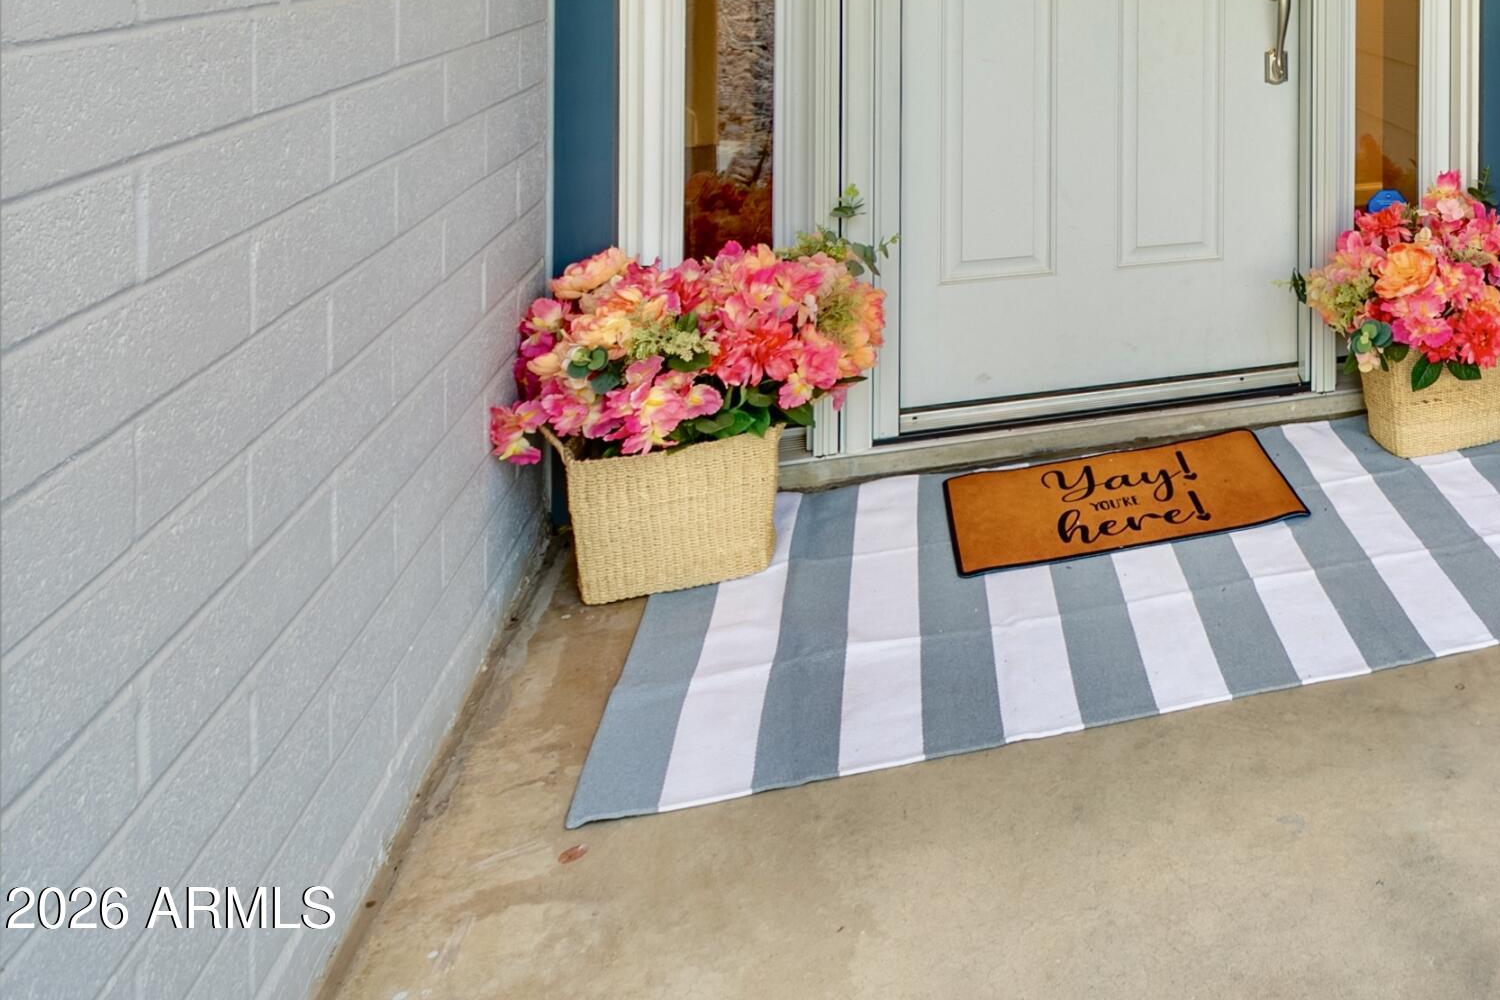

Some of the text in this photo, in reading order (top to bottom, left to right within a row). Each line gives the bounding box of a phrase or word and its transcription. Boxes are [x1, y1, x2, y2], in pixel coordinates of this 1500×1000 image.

[1042, 451, 1198, 503] Yay!
[1058, 490, 1211, 544] here!
[1089, 495, 1140, 512] YOU'RE
